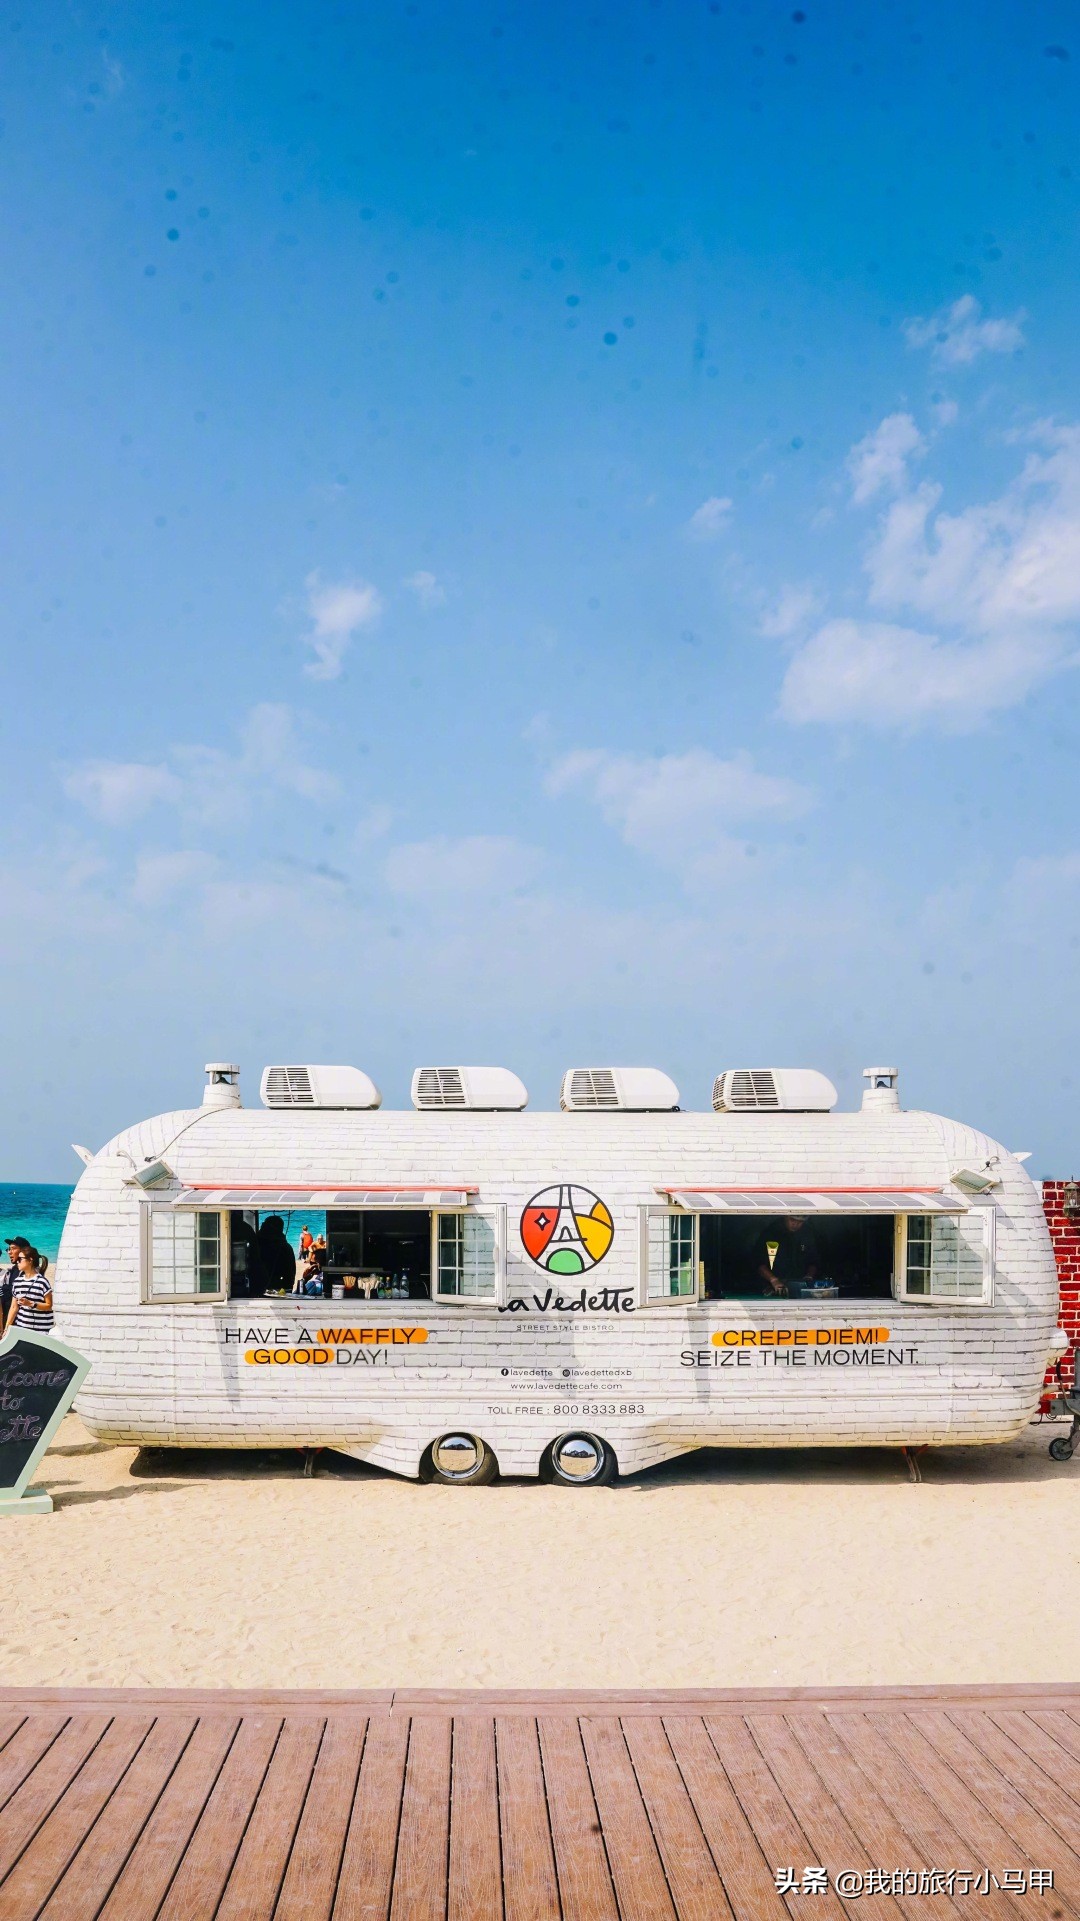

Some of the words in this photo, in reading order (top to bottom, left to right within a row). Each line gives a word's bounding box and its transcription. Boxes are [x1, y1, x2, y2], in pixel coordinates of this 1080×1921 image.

[498, 1299, 530, 1313] a
[533, 1286, 636, 1313] Vedette
[225, 1327, 289, 1344] HAVE
[297, 1328, 313, 1344] A
[320, 1328, 416, 1344] WAFFLY
[722, 1329, 809, 1346] CREPE
[816, 1328, 879, 1345] DIEM!
[253, 1348, 329, 1365] GOOD
[336, 1348, 388, 1365] DAY!
[680, 1350, 752, 1367] SEIZE
[757, 1350, 806, 1366] THE
[814, 1348, 919, 1366] MOMENT.
[510, 1382, 623, 1390] www.lavedettecafe.com
[0, 1389, 25, 1411] to
[487, 1406, 512, 1415] TOLL
[515, 1406, 543, 1414] FREE
[553, 1405, 579, 1414] 800
[582, 1404, 616, 1414] 8333
[619, 1404, 645, 1414] 883
[0, 1414, 42, 1443] ette
